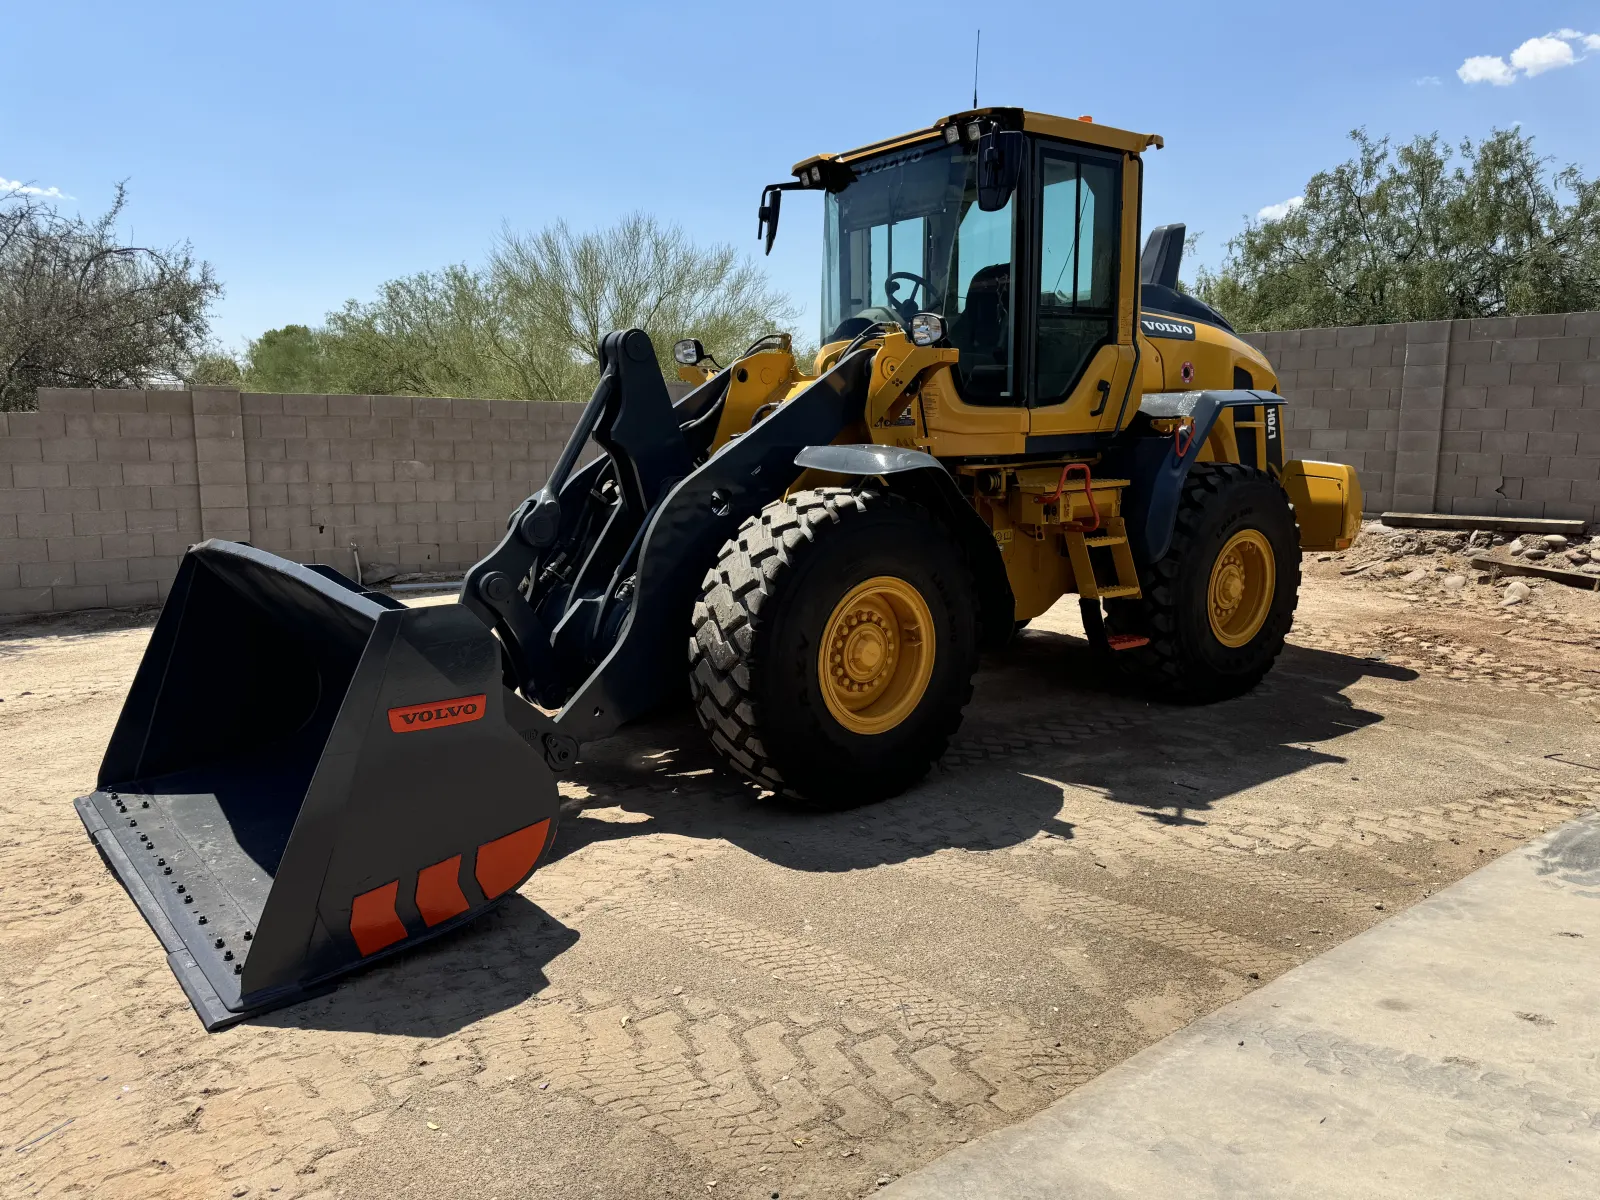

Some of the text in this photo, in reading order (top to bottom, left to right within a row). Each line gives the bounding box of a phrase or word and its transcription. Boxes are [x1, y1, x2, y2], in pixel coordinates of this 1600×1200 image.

[1141, 320, 1194, 335] VOLVO
[1267, 407, 1277, 440] L70H
[399, 703, 478, 725] VOLVO
